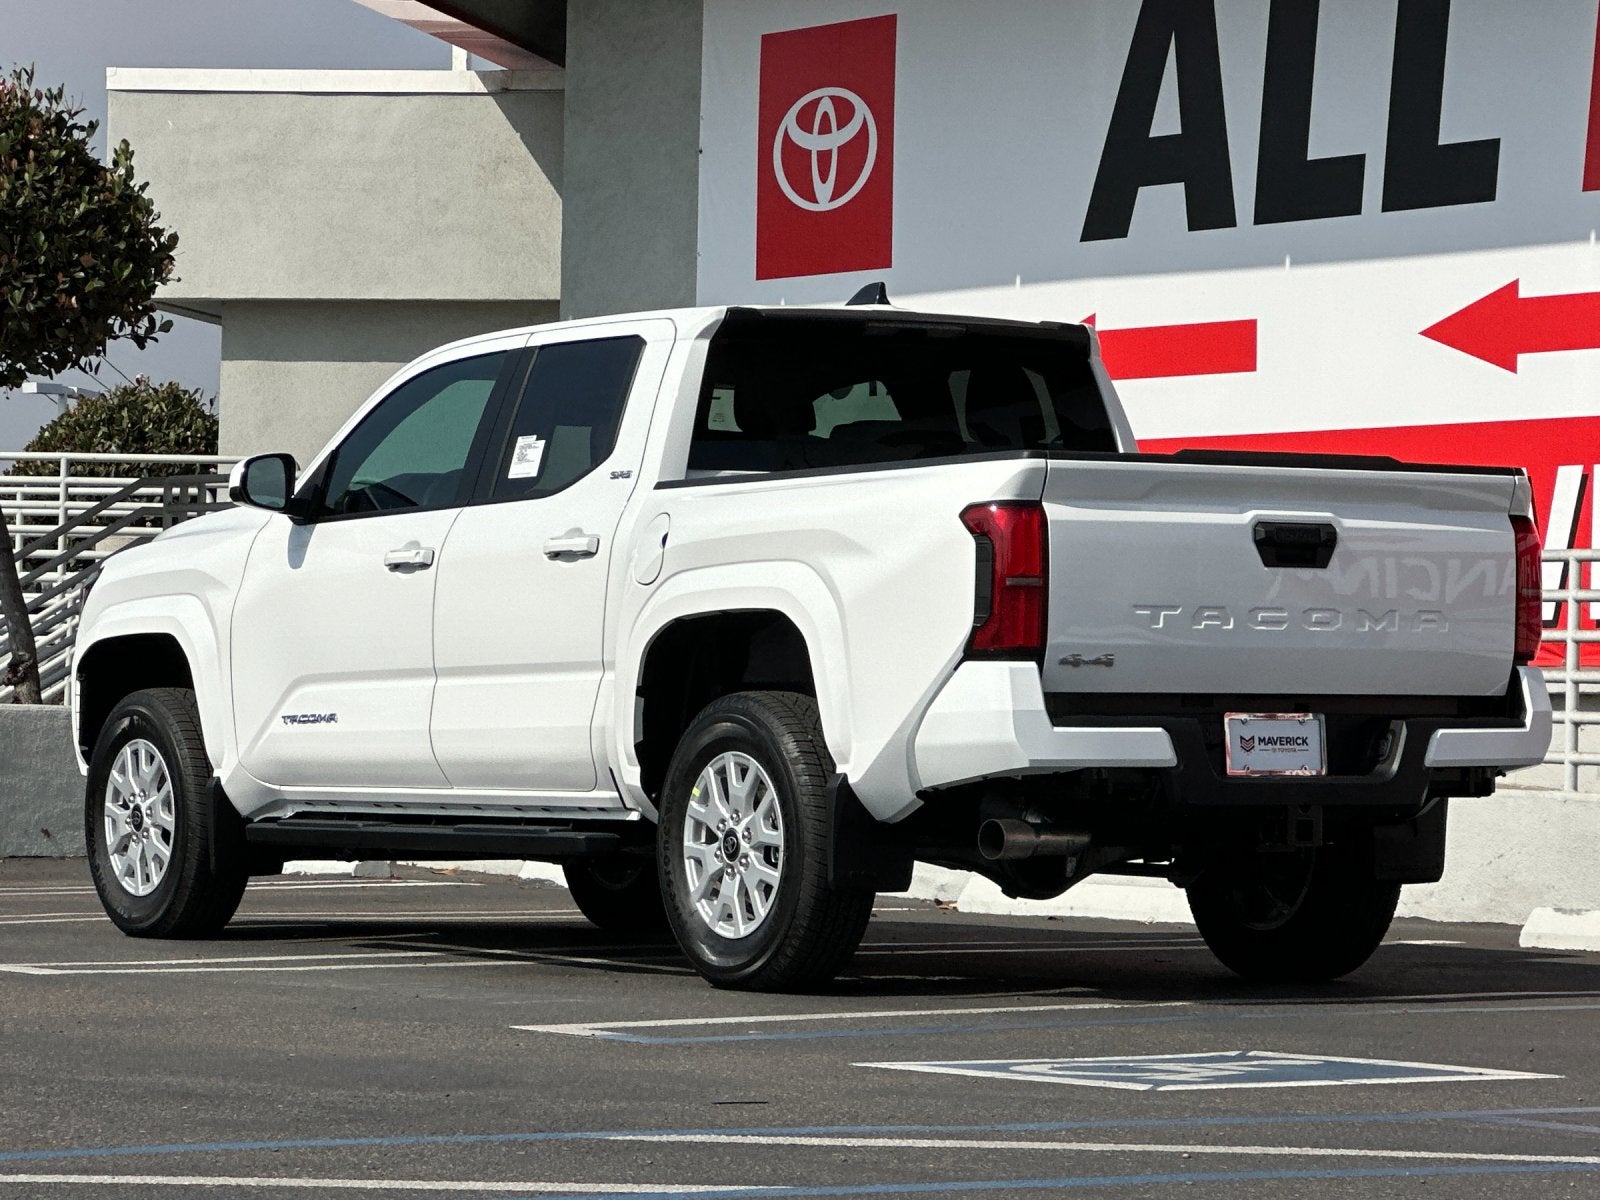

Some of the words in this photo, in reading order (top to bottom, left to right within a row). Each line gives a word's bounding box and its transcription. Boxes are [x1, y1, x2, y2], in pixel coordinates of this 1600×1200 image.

[1080, 0, 1501, 243] ALL
[1132, 604, 1449, 633] TACOMA
[281, 713, 338, 725] TACOMA
[1258, 736, 1309, 747] MAVERICK
